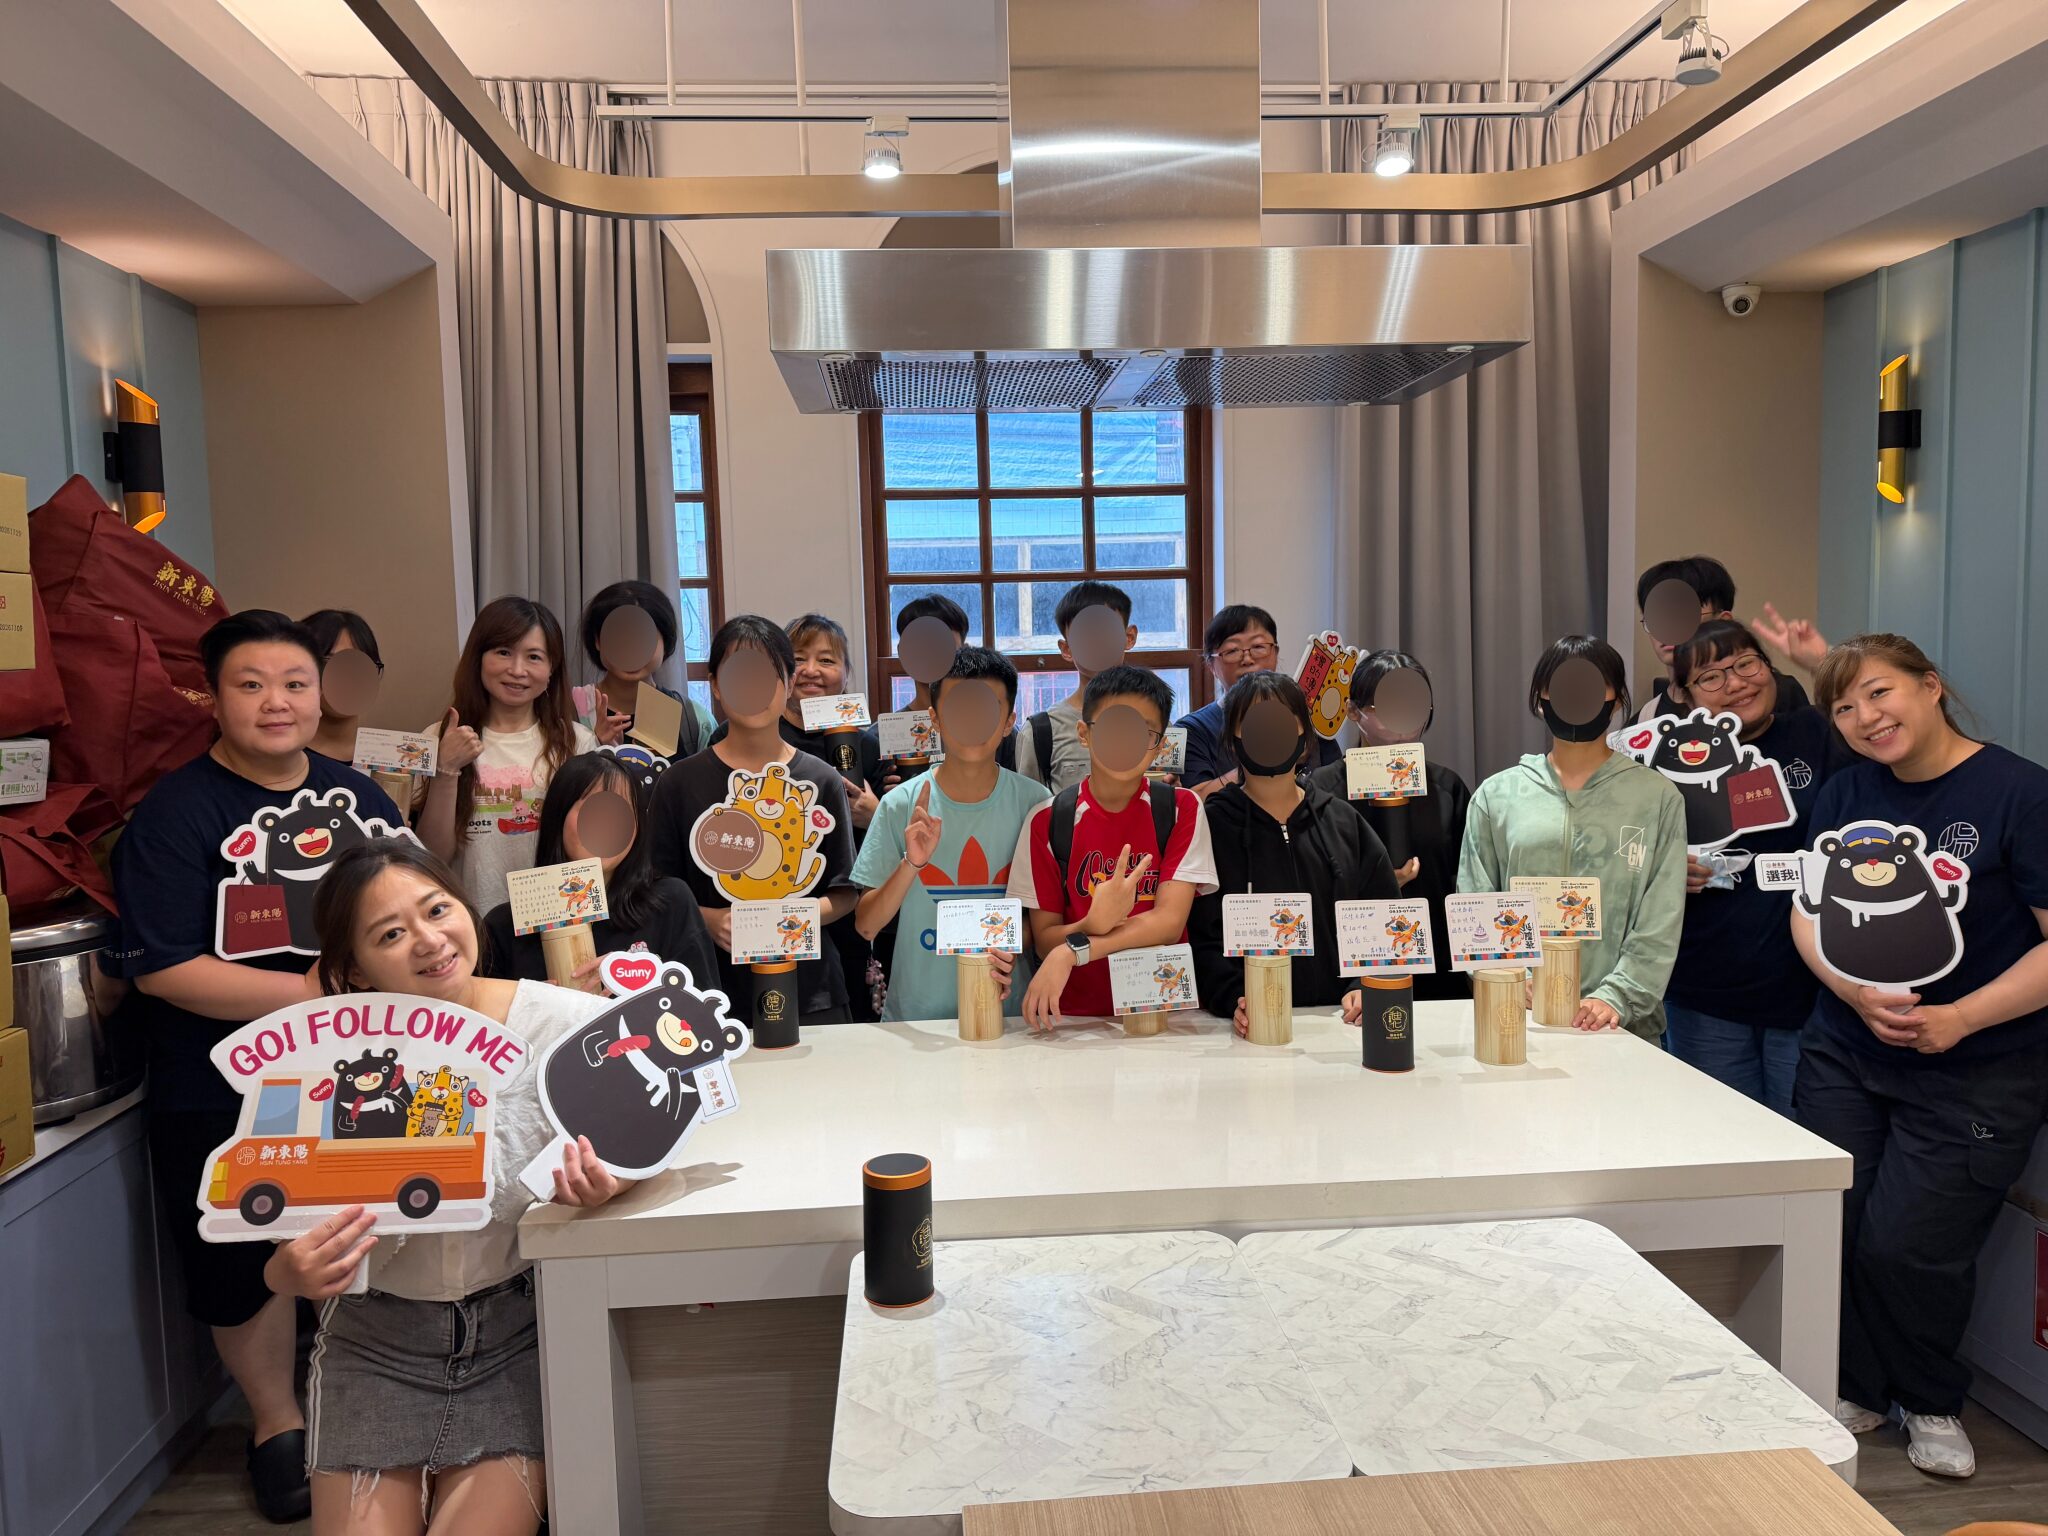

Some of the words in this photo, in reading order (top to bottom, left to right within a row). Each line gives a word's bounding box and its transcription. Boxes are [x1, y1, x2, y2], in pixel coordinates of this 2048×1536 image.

[157, 561, 216, 607] 新東陽
[468, 819, 492, 827] oots
[233, 834, 253, 855] Sunny
[720, 832, 756, 848] 新東陽
[1628, 842, 1647, 867] GN
[1766, 868, 1800, 882] 選我!
[1936, 862, 1958, 878] Sunny
[250, 908, 282, 920] 新東陽
[128, 949, 144, 957] 1967
[615, 967, 651, 980] Sunny
[229, 1021, 297, 1076] GO!
[307, 1004, 466, 1046] FOLLOW
[465, 1026, 524, 1075] ME
[312, 1083, 332, 1099] Sunny
[259, 1143, 309, 1160] 新東陽
